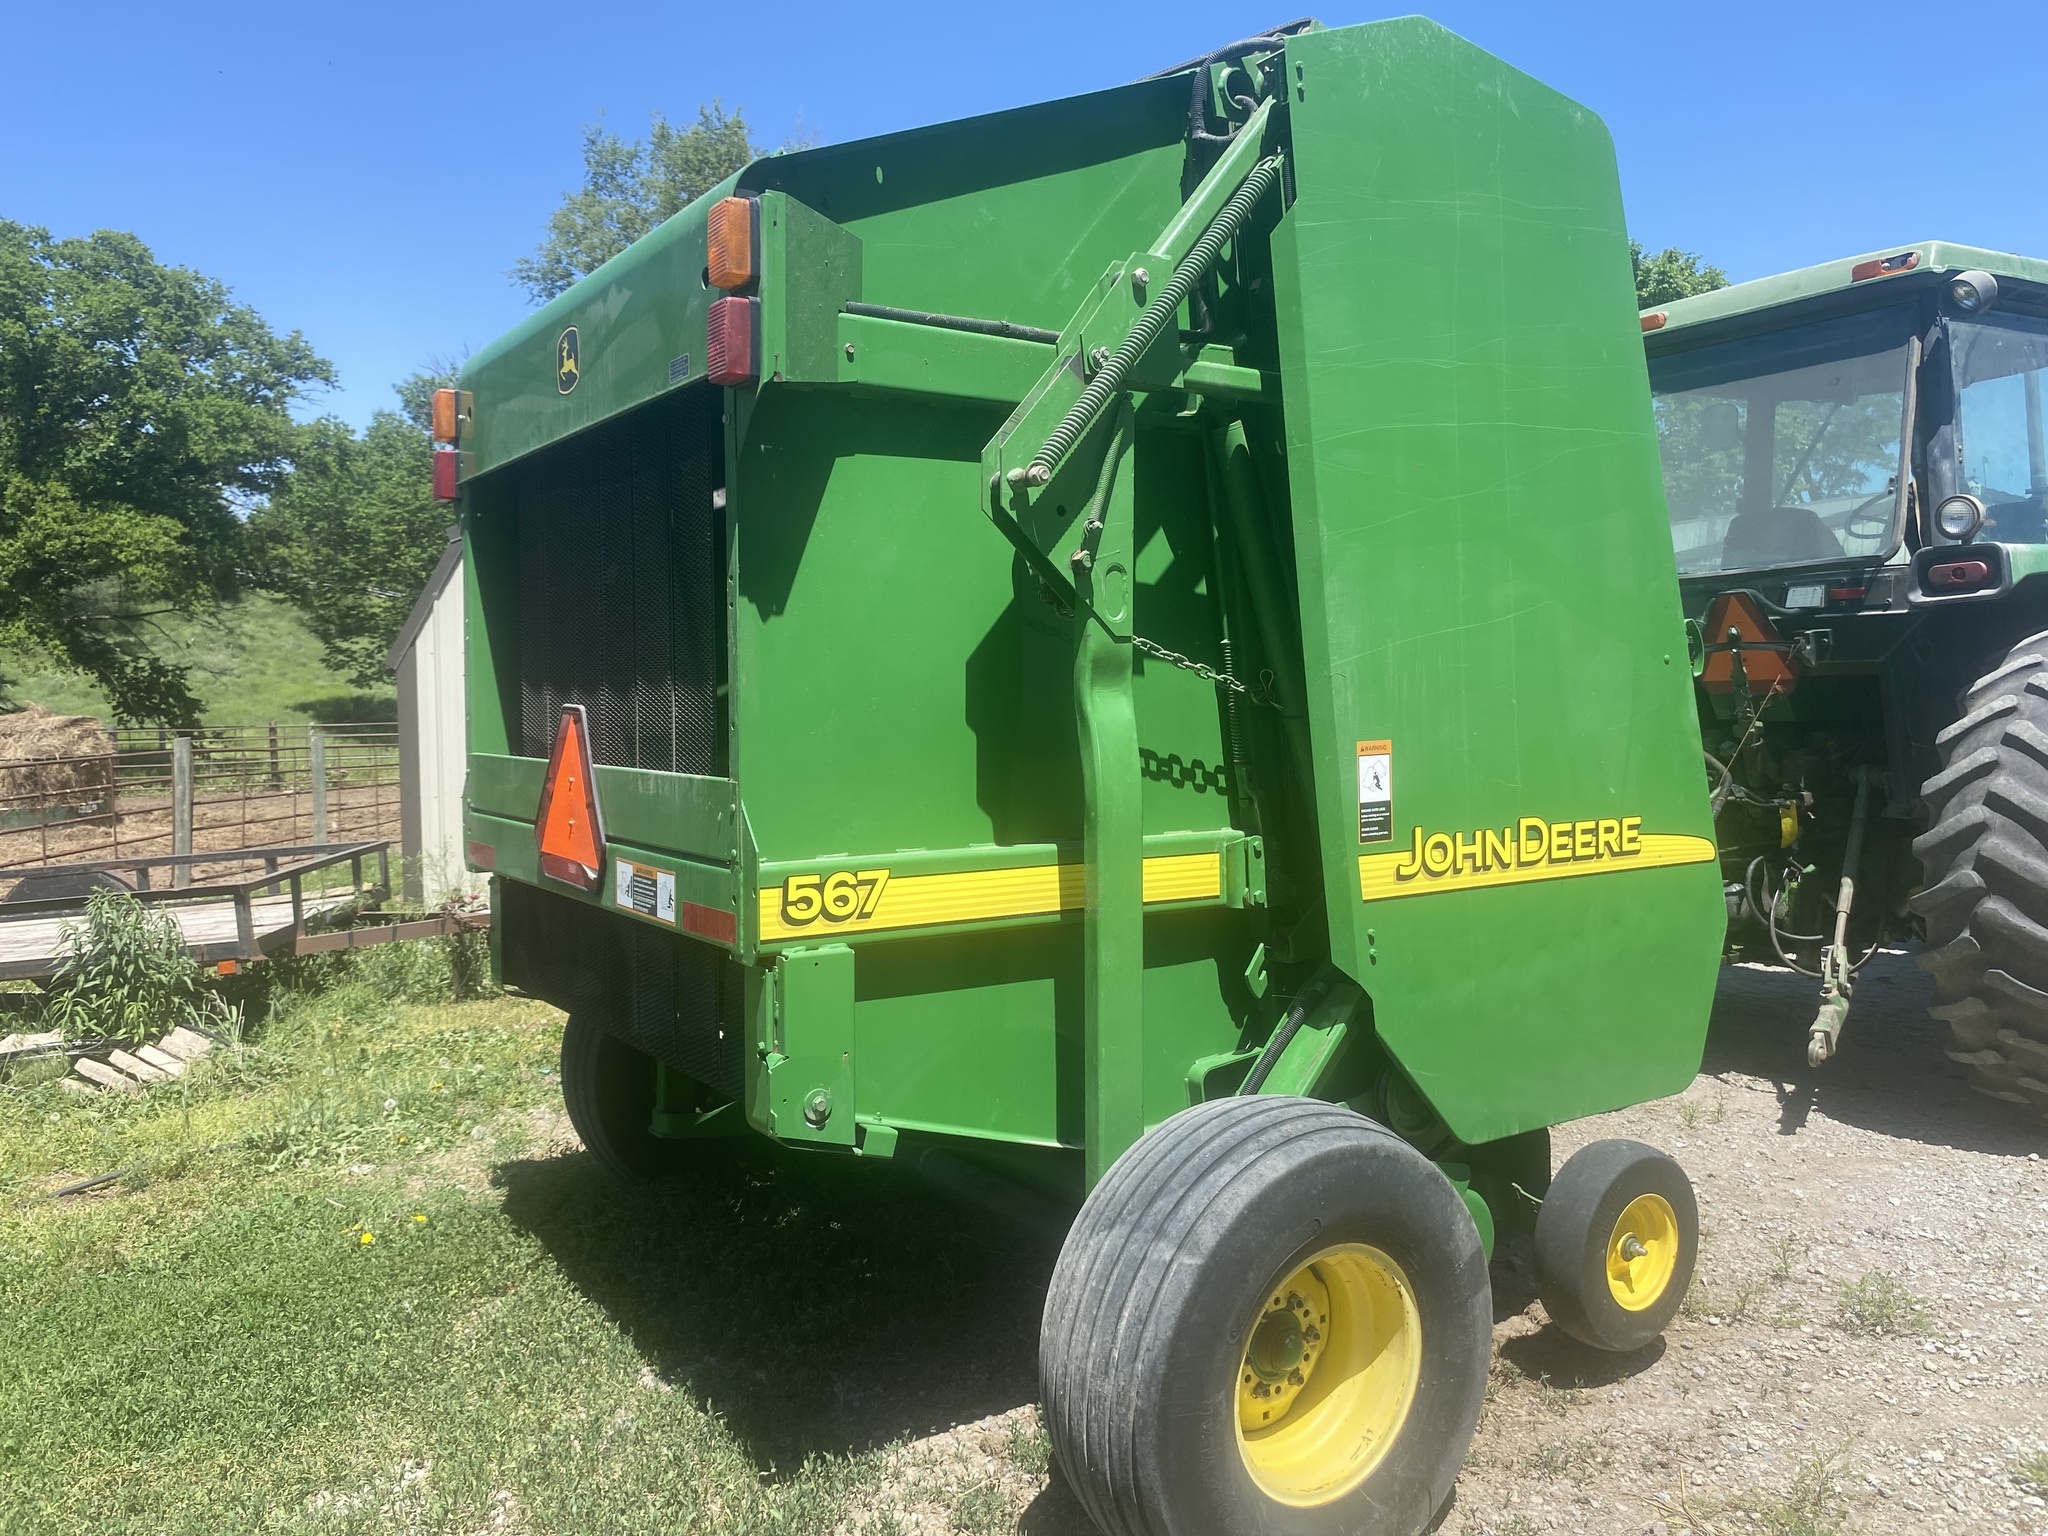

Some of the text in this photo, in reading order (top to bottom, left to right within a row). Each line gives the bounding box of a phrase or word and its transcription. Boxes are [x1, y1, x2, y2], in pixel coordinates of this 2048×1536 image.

[1364, 744, 1387, 752] WARNING
[1396, 815, 1642, 882] JOHN DEERE
[780, 868, 891, 927] 567
